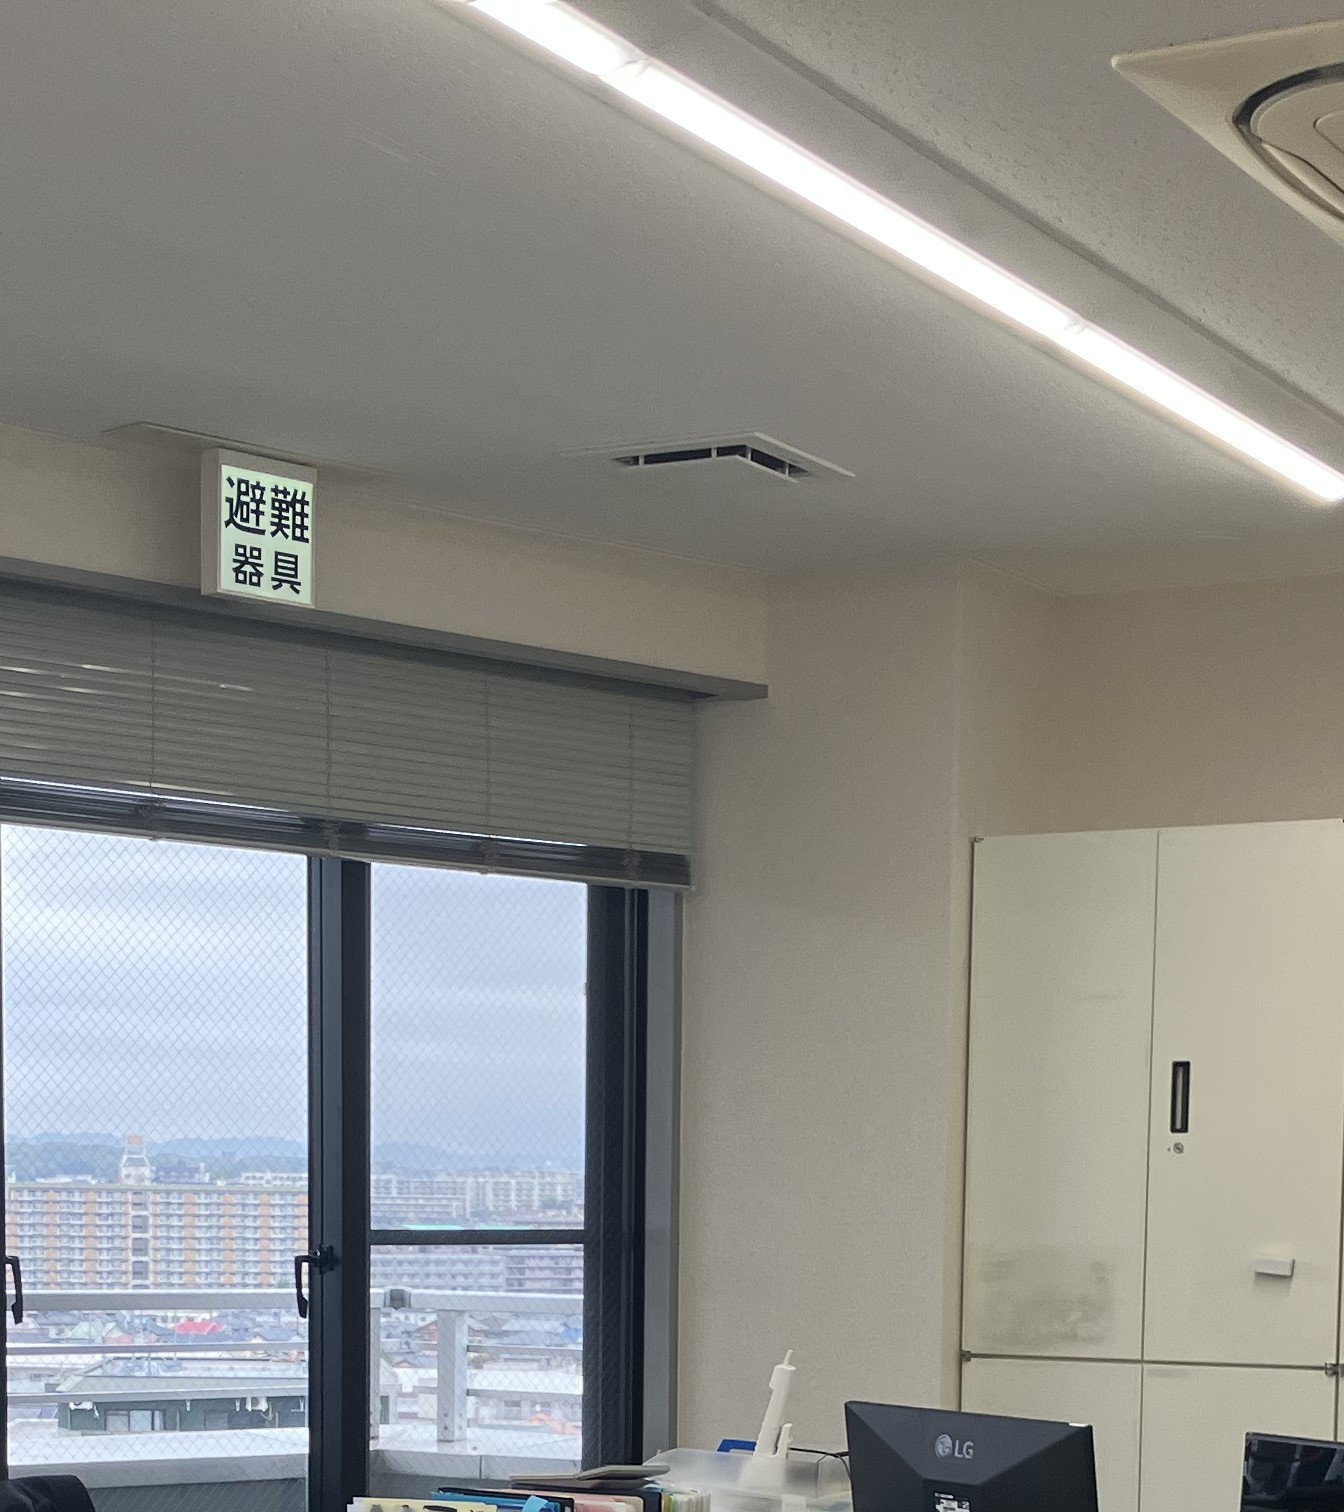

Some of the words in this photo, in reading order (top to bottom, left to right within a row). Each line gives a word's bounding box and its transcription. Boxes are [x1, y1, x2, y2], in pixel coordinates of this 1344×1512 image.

[224, 476, 310, 543] 避難
[232, 543, 302, 594] 器具
[954, 1440, 974, 1459] LG
